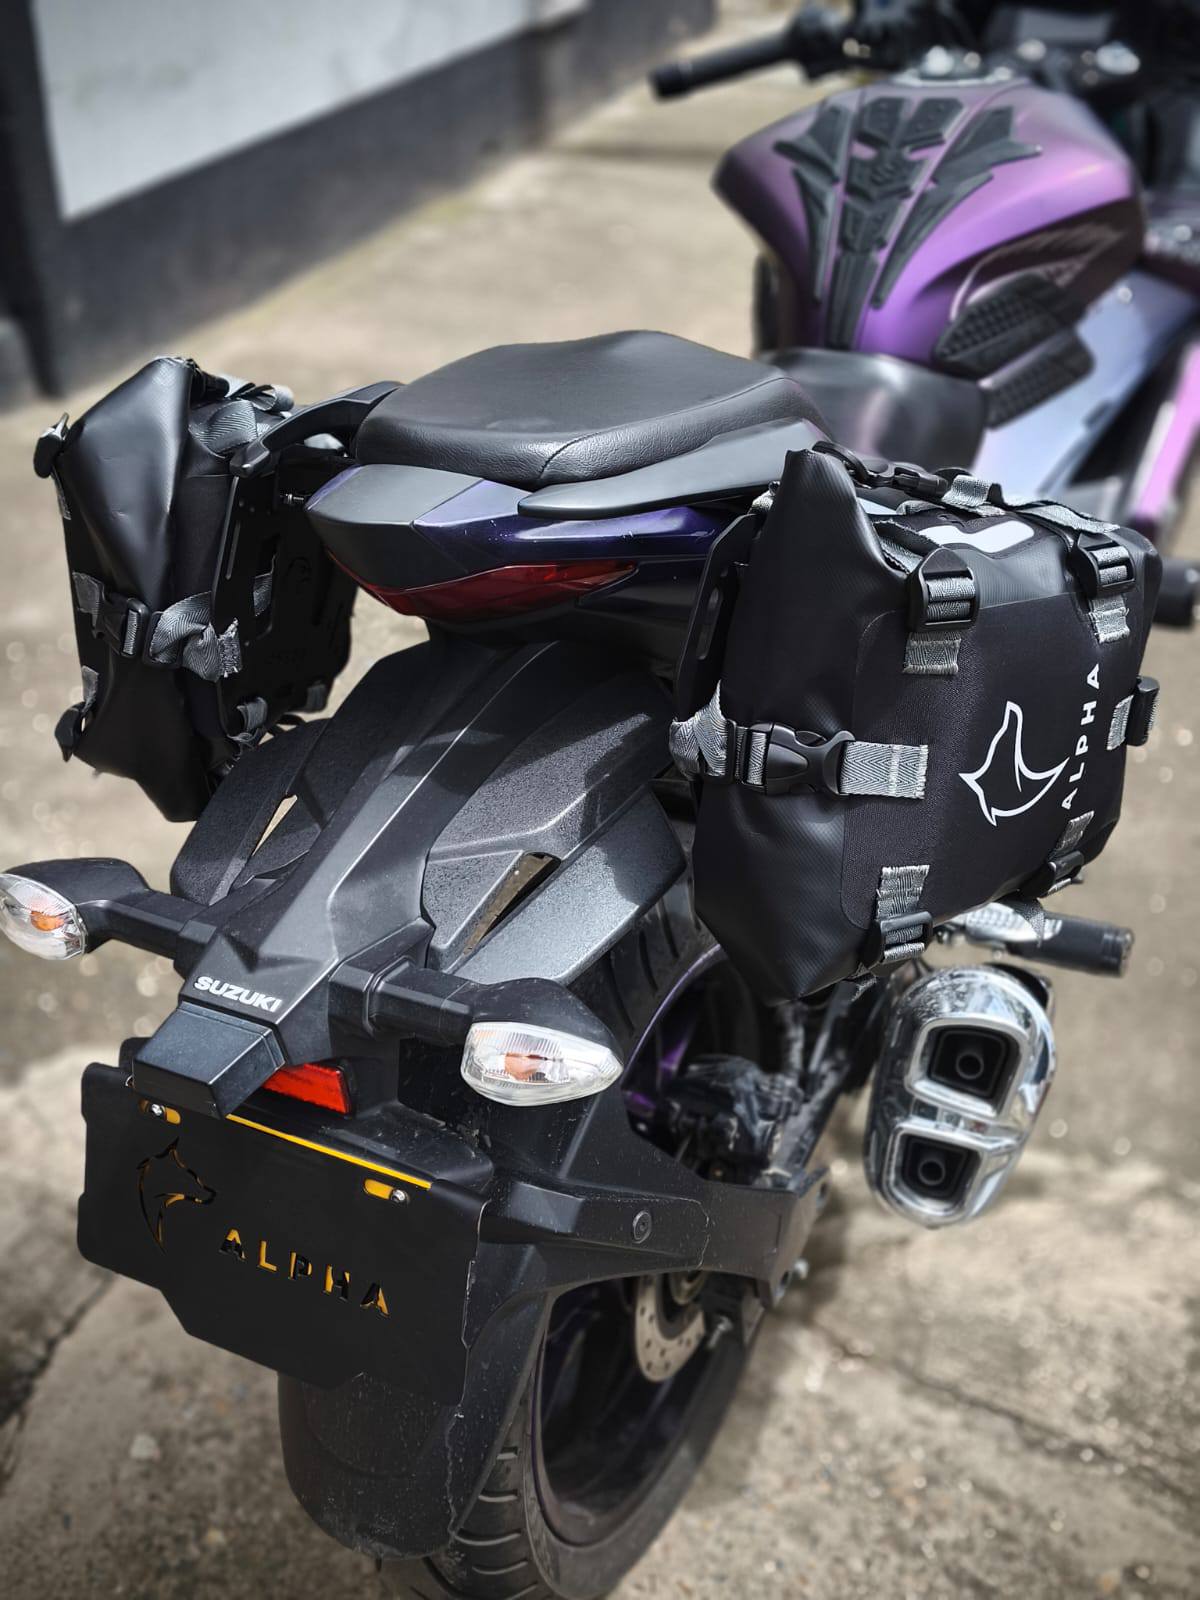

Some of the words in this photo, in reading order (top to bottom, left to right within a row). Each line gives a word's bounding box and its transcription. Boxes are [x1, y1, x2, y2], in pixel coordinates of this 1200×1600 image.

[1062, 663, 1100, 810] ALPHA
[194, 976, 283, 1013] SUZUKI
[219, 1228, 391, 1318] ALPHA
